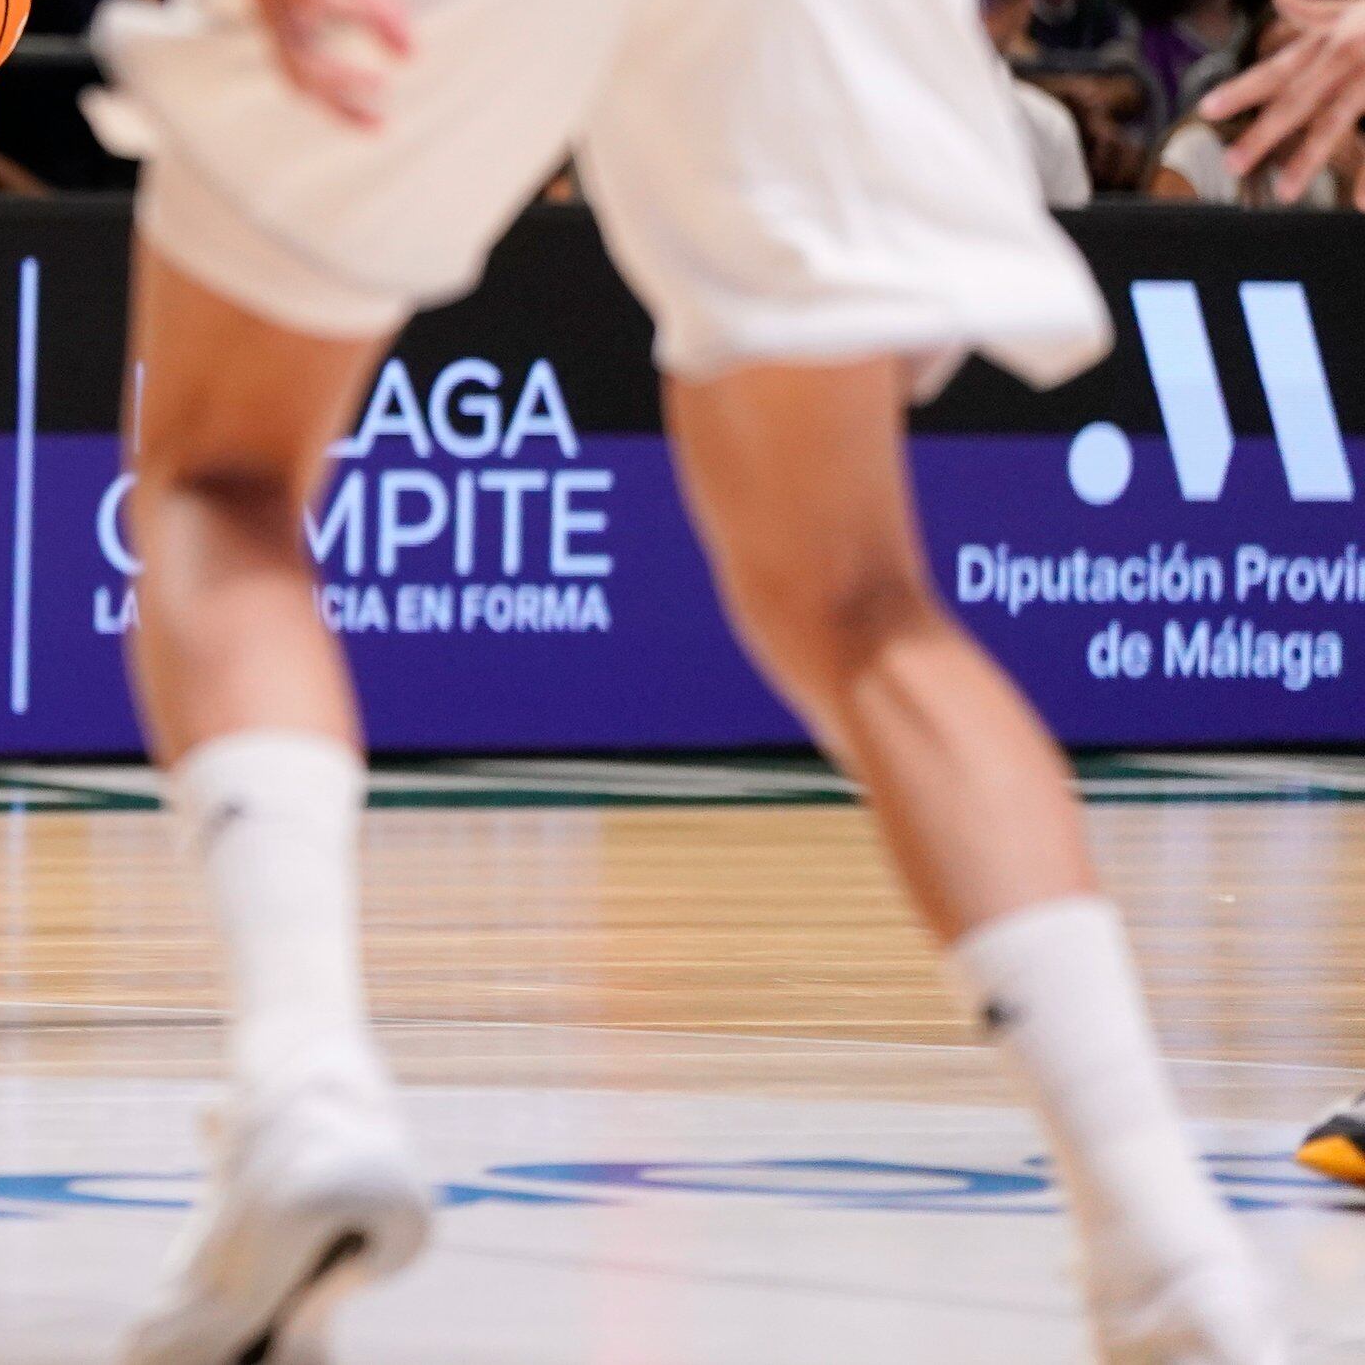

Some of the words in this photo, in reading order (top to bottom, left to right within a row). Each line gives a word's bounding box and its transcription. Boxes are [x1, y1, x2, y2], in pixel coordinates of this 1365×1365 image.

[96, 469, 614, 577] CMPITE
[395, 584, 454, 632] EN
[460, 583, 610, 632] FORMA
[957, 543, 1223, 616] Diputación
[1087, 619, 1151, 679] de
[1163, 618, 1343, 691] Málaga
